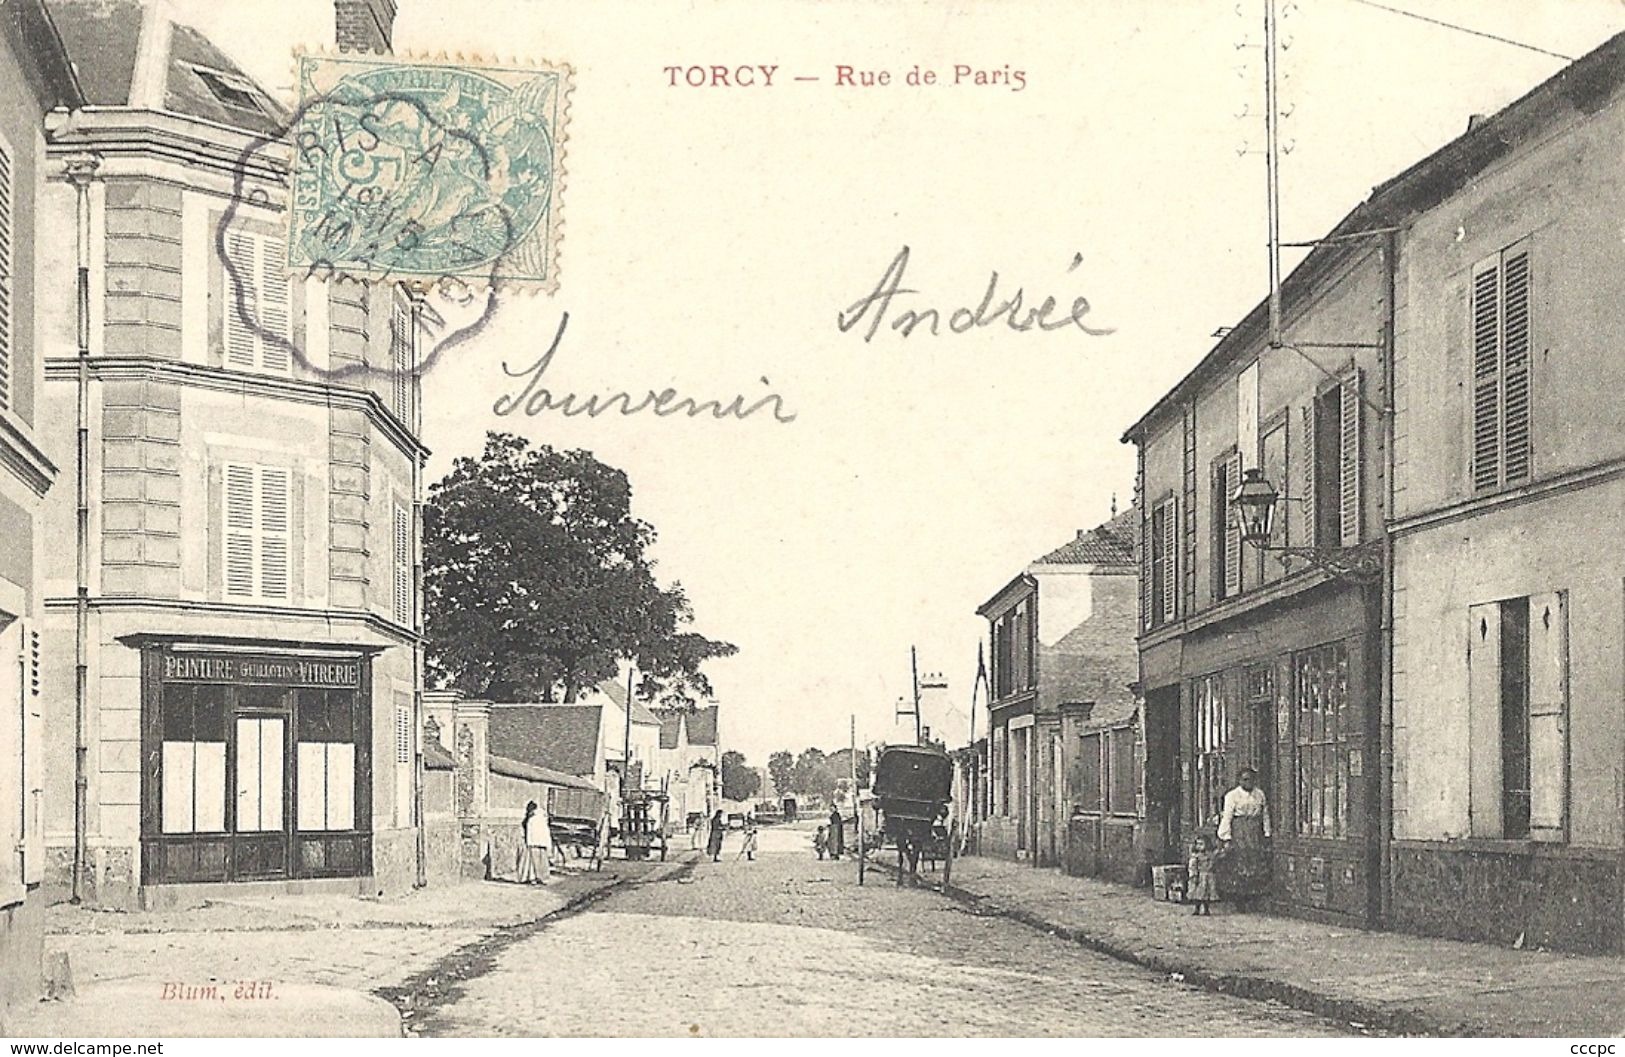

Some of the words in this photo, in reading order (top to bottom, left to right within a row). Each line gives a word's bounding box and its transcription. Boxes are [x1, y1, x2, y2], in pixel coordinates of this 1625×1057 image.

[839, 245, 1119, 343] Andrée
[493, 311, 797, 423] Souvenir
[165, 656, 234, 681] PEINTURE
[298, 662, 358, 685] VITRERIE
